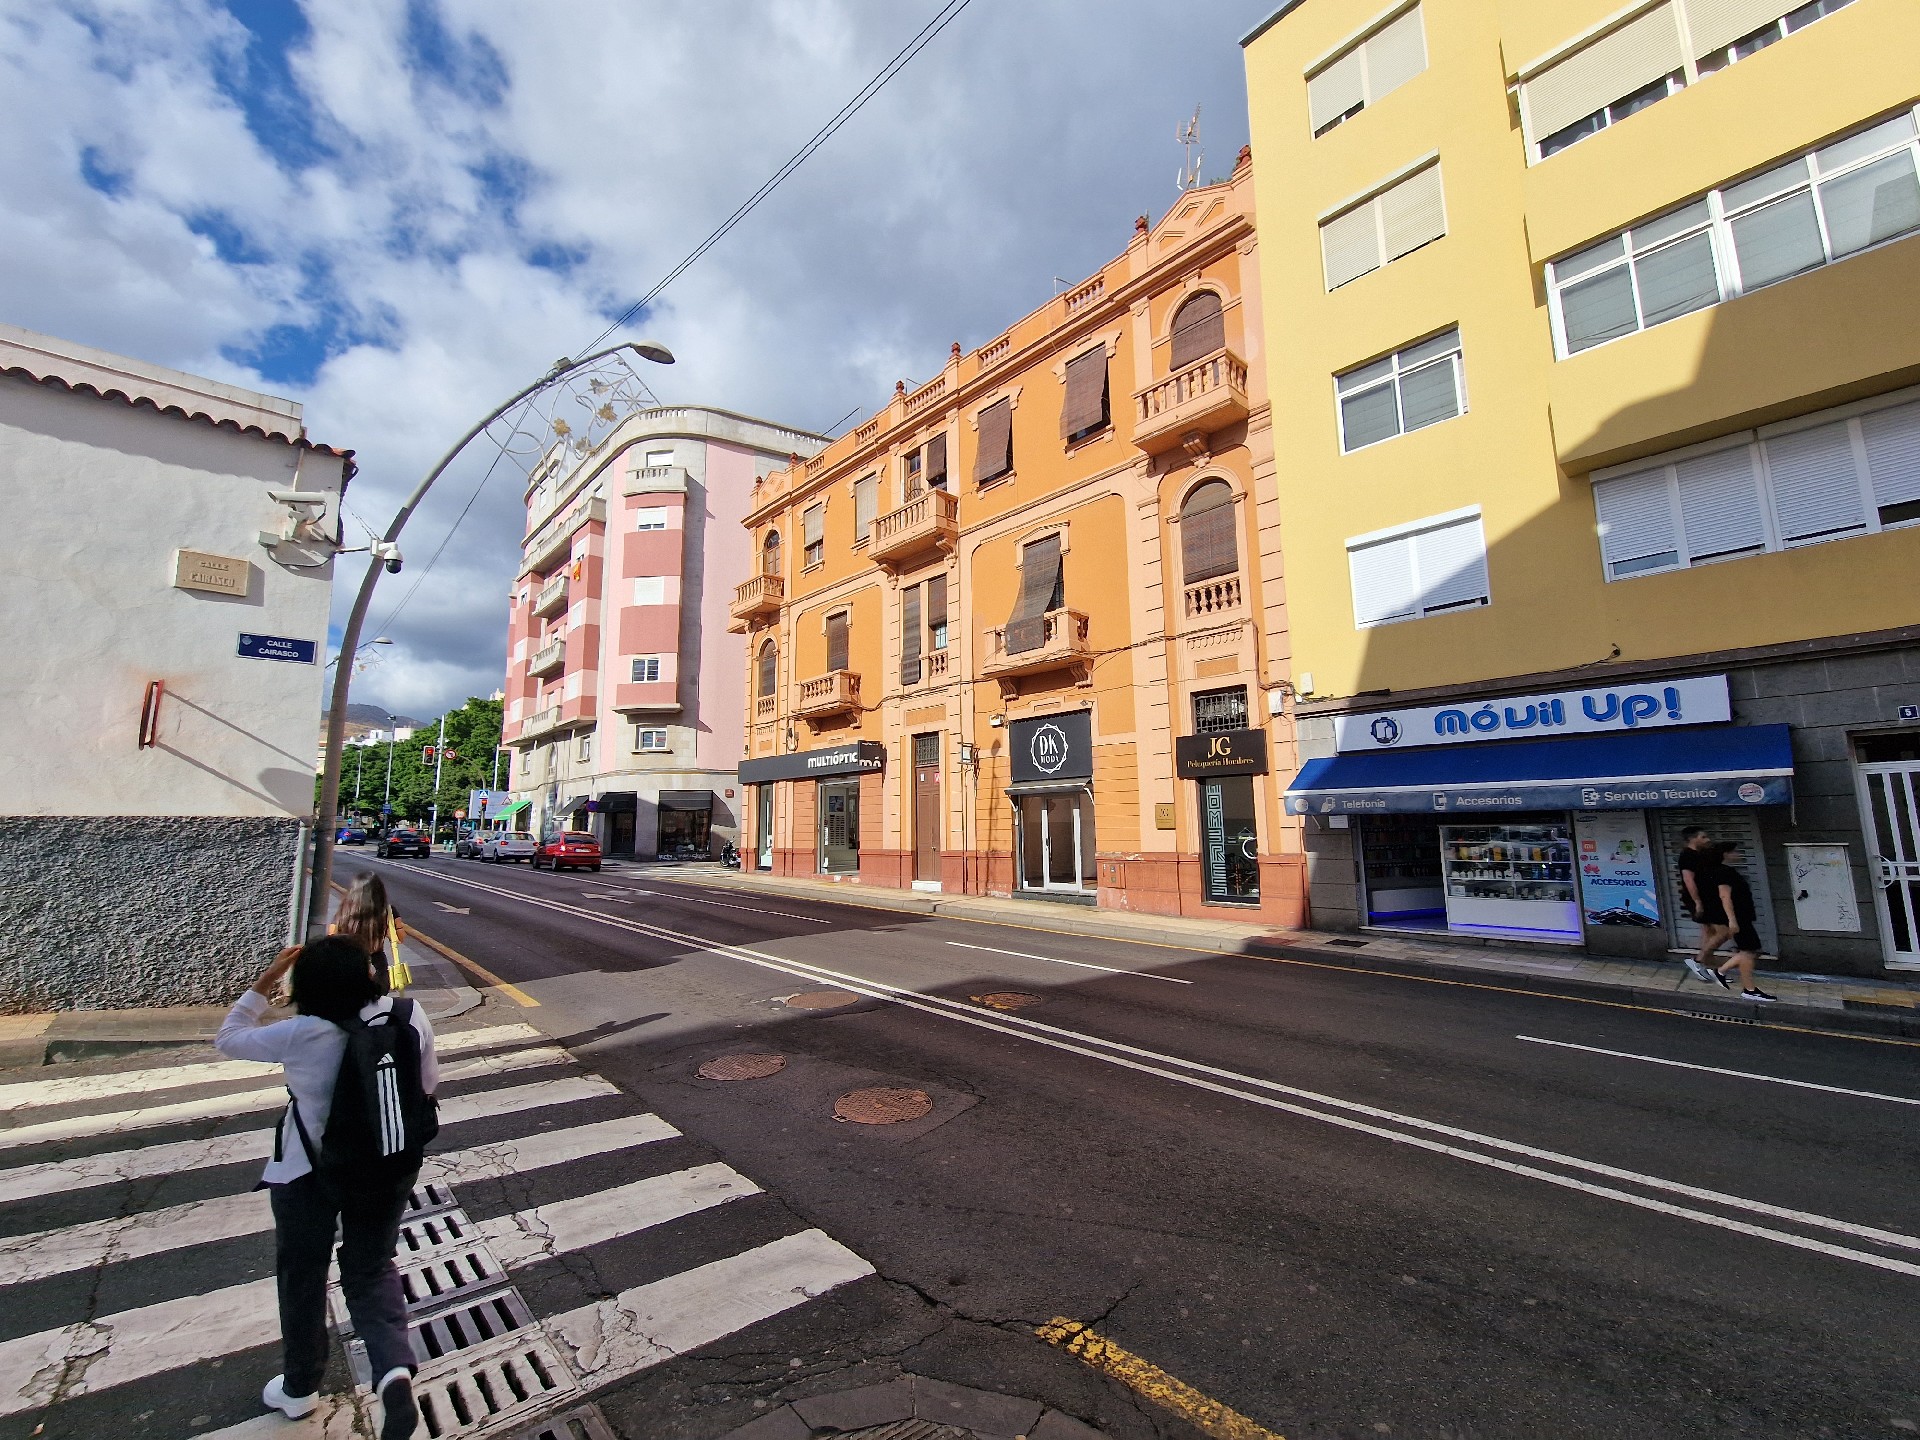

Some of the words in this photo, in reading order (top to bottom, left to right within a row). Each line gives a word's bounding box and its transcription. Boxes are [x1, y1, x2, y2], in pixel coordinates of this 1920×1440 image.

[191, 572, 235, 587] CAIRASCO
[267, 640, 292, 649] CALLE
[258, 648, 299, 658] CAIRASCO
[1904, 708, 1912, 717] 5
[1040, 733, 1059, 756] DK
[1207, 736, 1232, 758] JG
[808, 751, 858, 768] MULTIÓPTIC
[1223, 756, 1255, 767] Hombres
[1341, 798, 1386, 809] Telefonía
[1455, 795, 1523, 807] Accesorios
[1604, 789, 1659, 802] Servicio
[1661, 788, 1718, 800] Técnico
[1590, 878, 1647, 887] ACCESORIOS
